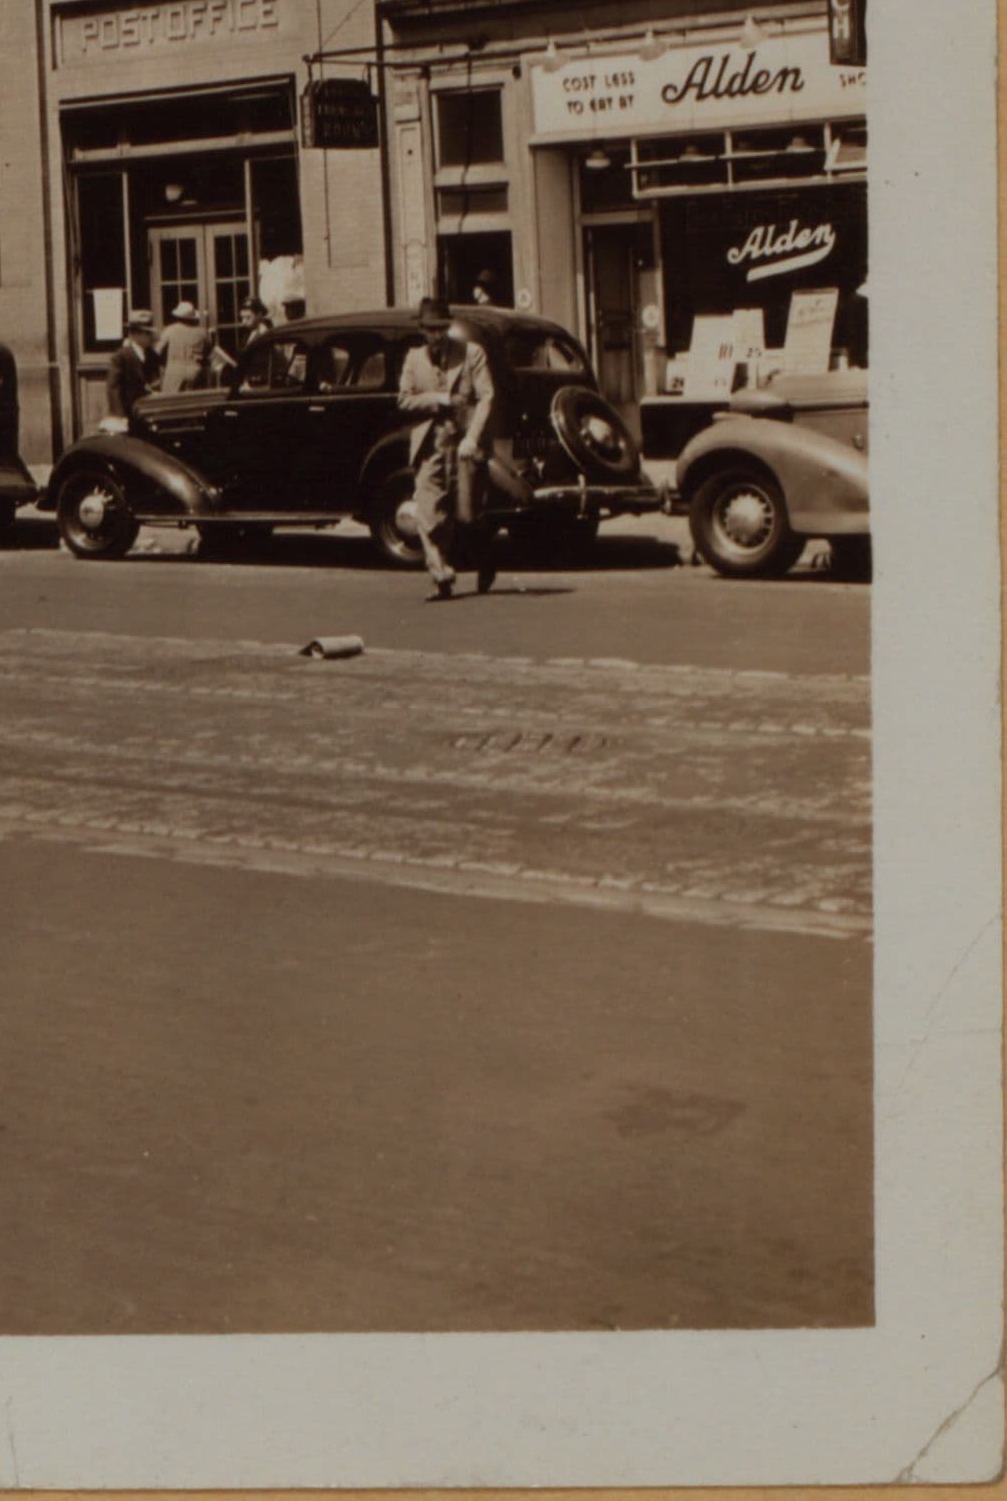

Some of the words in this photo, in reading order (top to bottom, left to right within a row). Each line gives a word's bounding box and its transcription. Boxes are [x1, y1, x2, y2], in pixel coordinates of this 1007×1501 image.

[82, 9, 161, 53] POST
[563, 75, 597, 92] COST
[661, 51, 805, 104] Alden
[567, 100, 584, 116] TO
[727, 219, 836, 268] Alden
